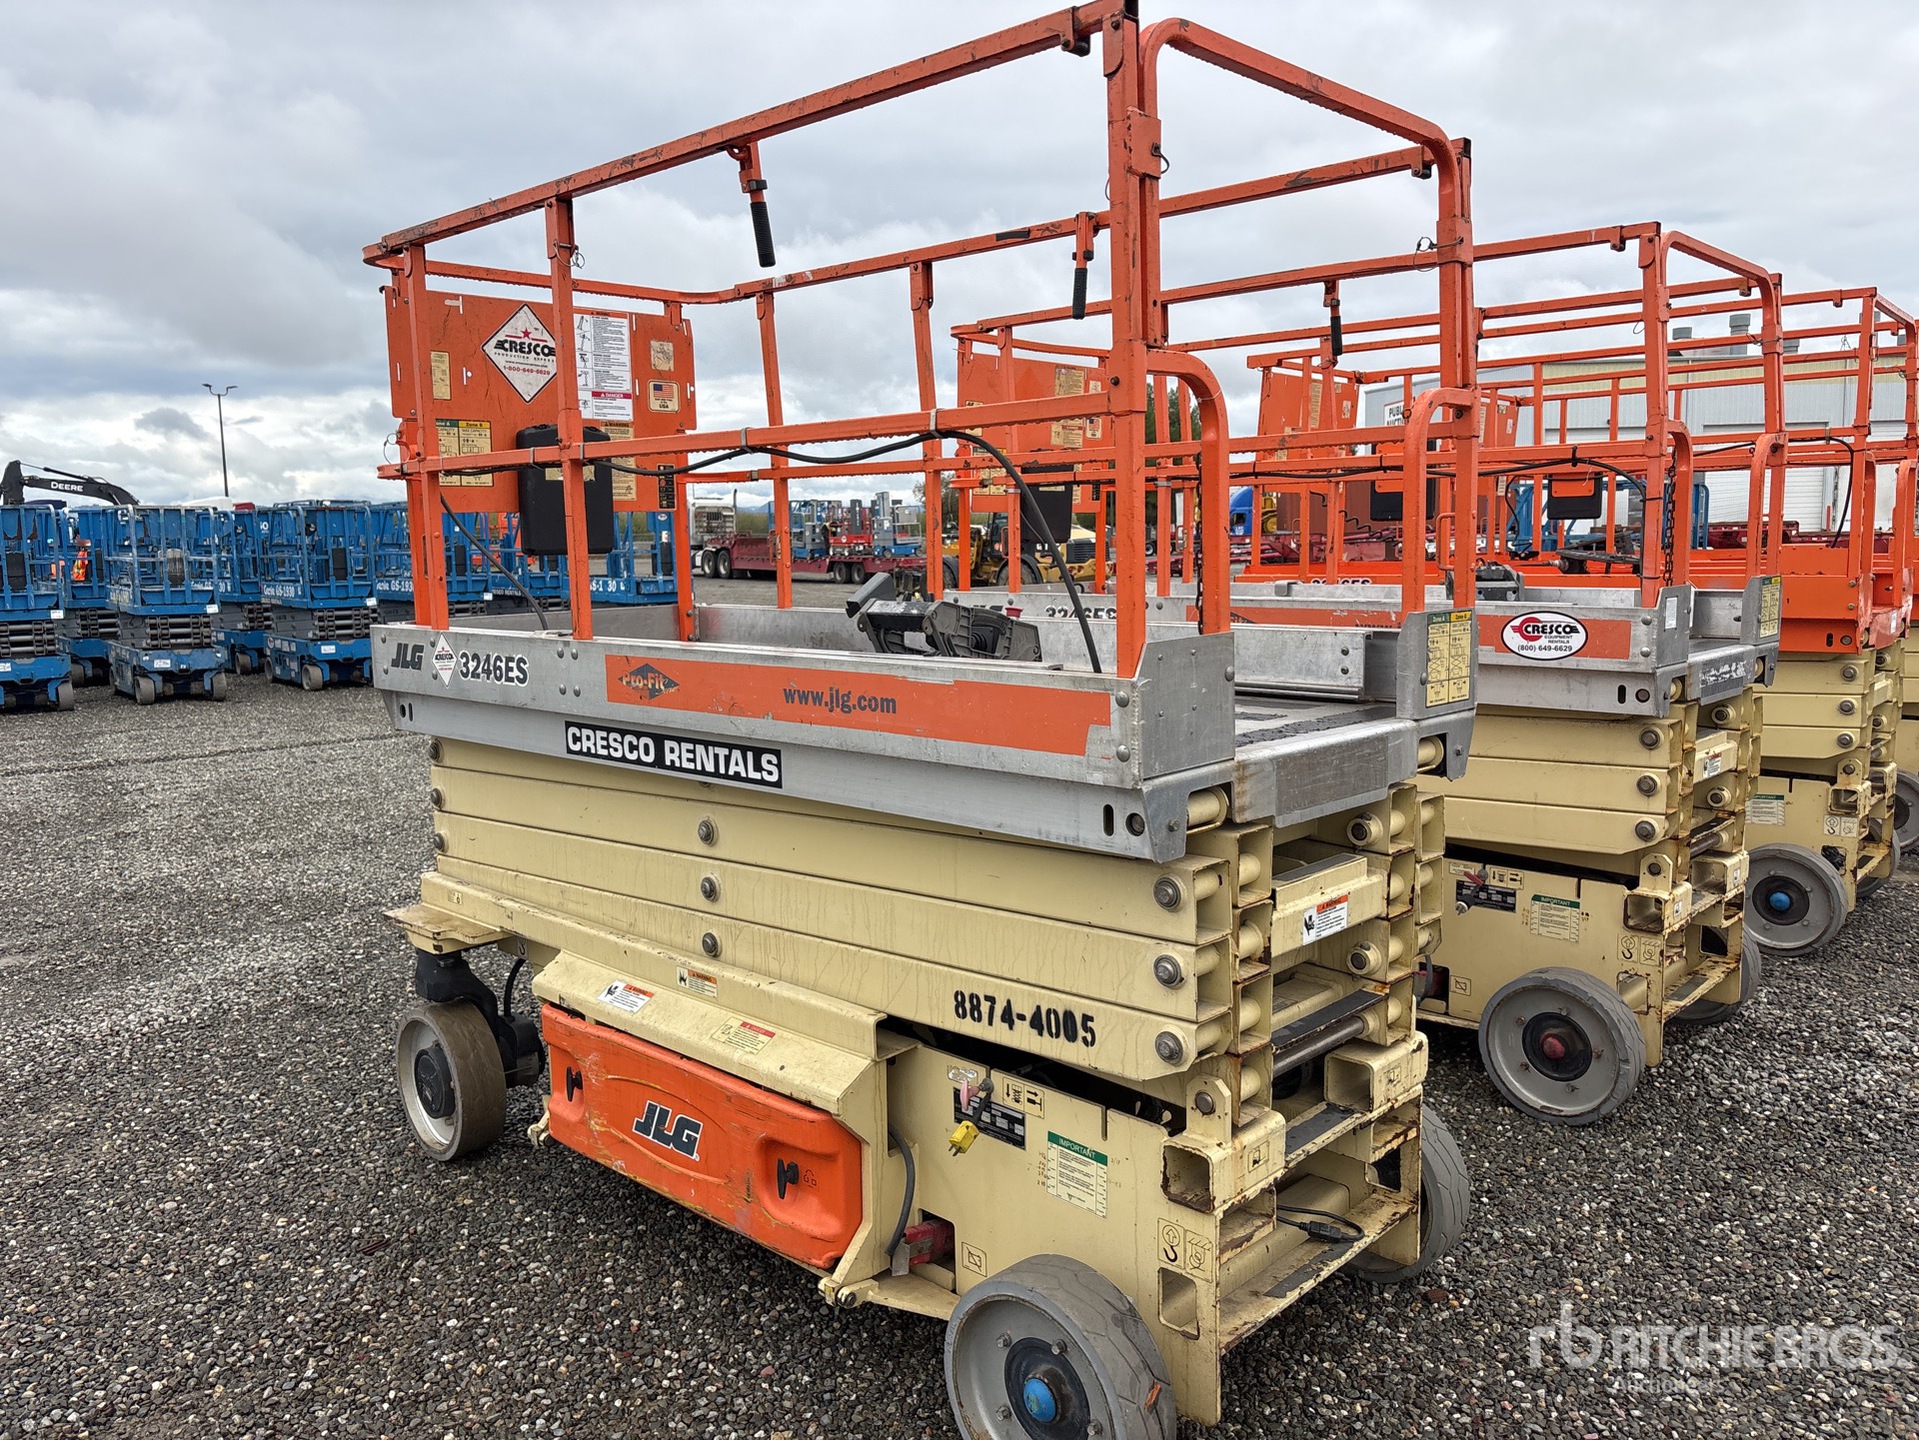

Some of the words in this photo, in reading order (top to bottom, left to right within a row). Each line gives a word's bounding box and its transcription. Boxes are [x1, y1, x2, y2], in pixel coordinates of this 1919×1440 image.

[495, 339, 556, 357] CRESCO
[51, 481, 83, 492] DEERE
[1524, 624, 1579, 635] CRESCO
[391, 643, 424, 670] JLG
[459, 650, 529, 686] 3246ES
[783, 687, 897, 714] www.jlg.com
[567, 726, 655, 763] CRESCO
[664, 740, 779, 782] RENTALS
[1541, 897, 1571, 907] IMPORTANT
[954, 990, 1096, 1048] 8874-4005
[632, 1100, 703, 1158] JLG
[1059, 1138, 1096, 1158] IMPORTANT
